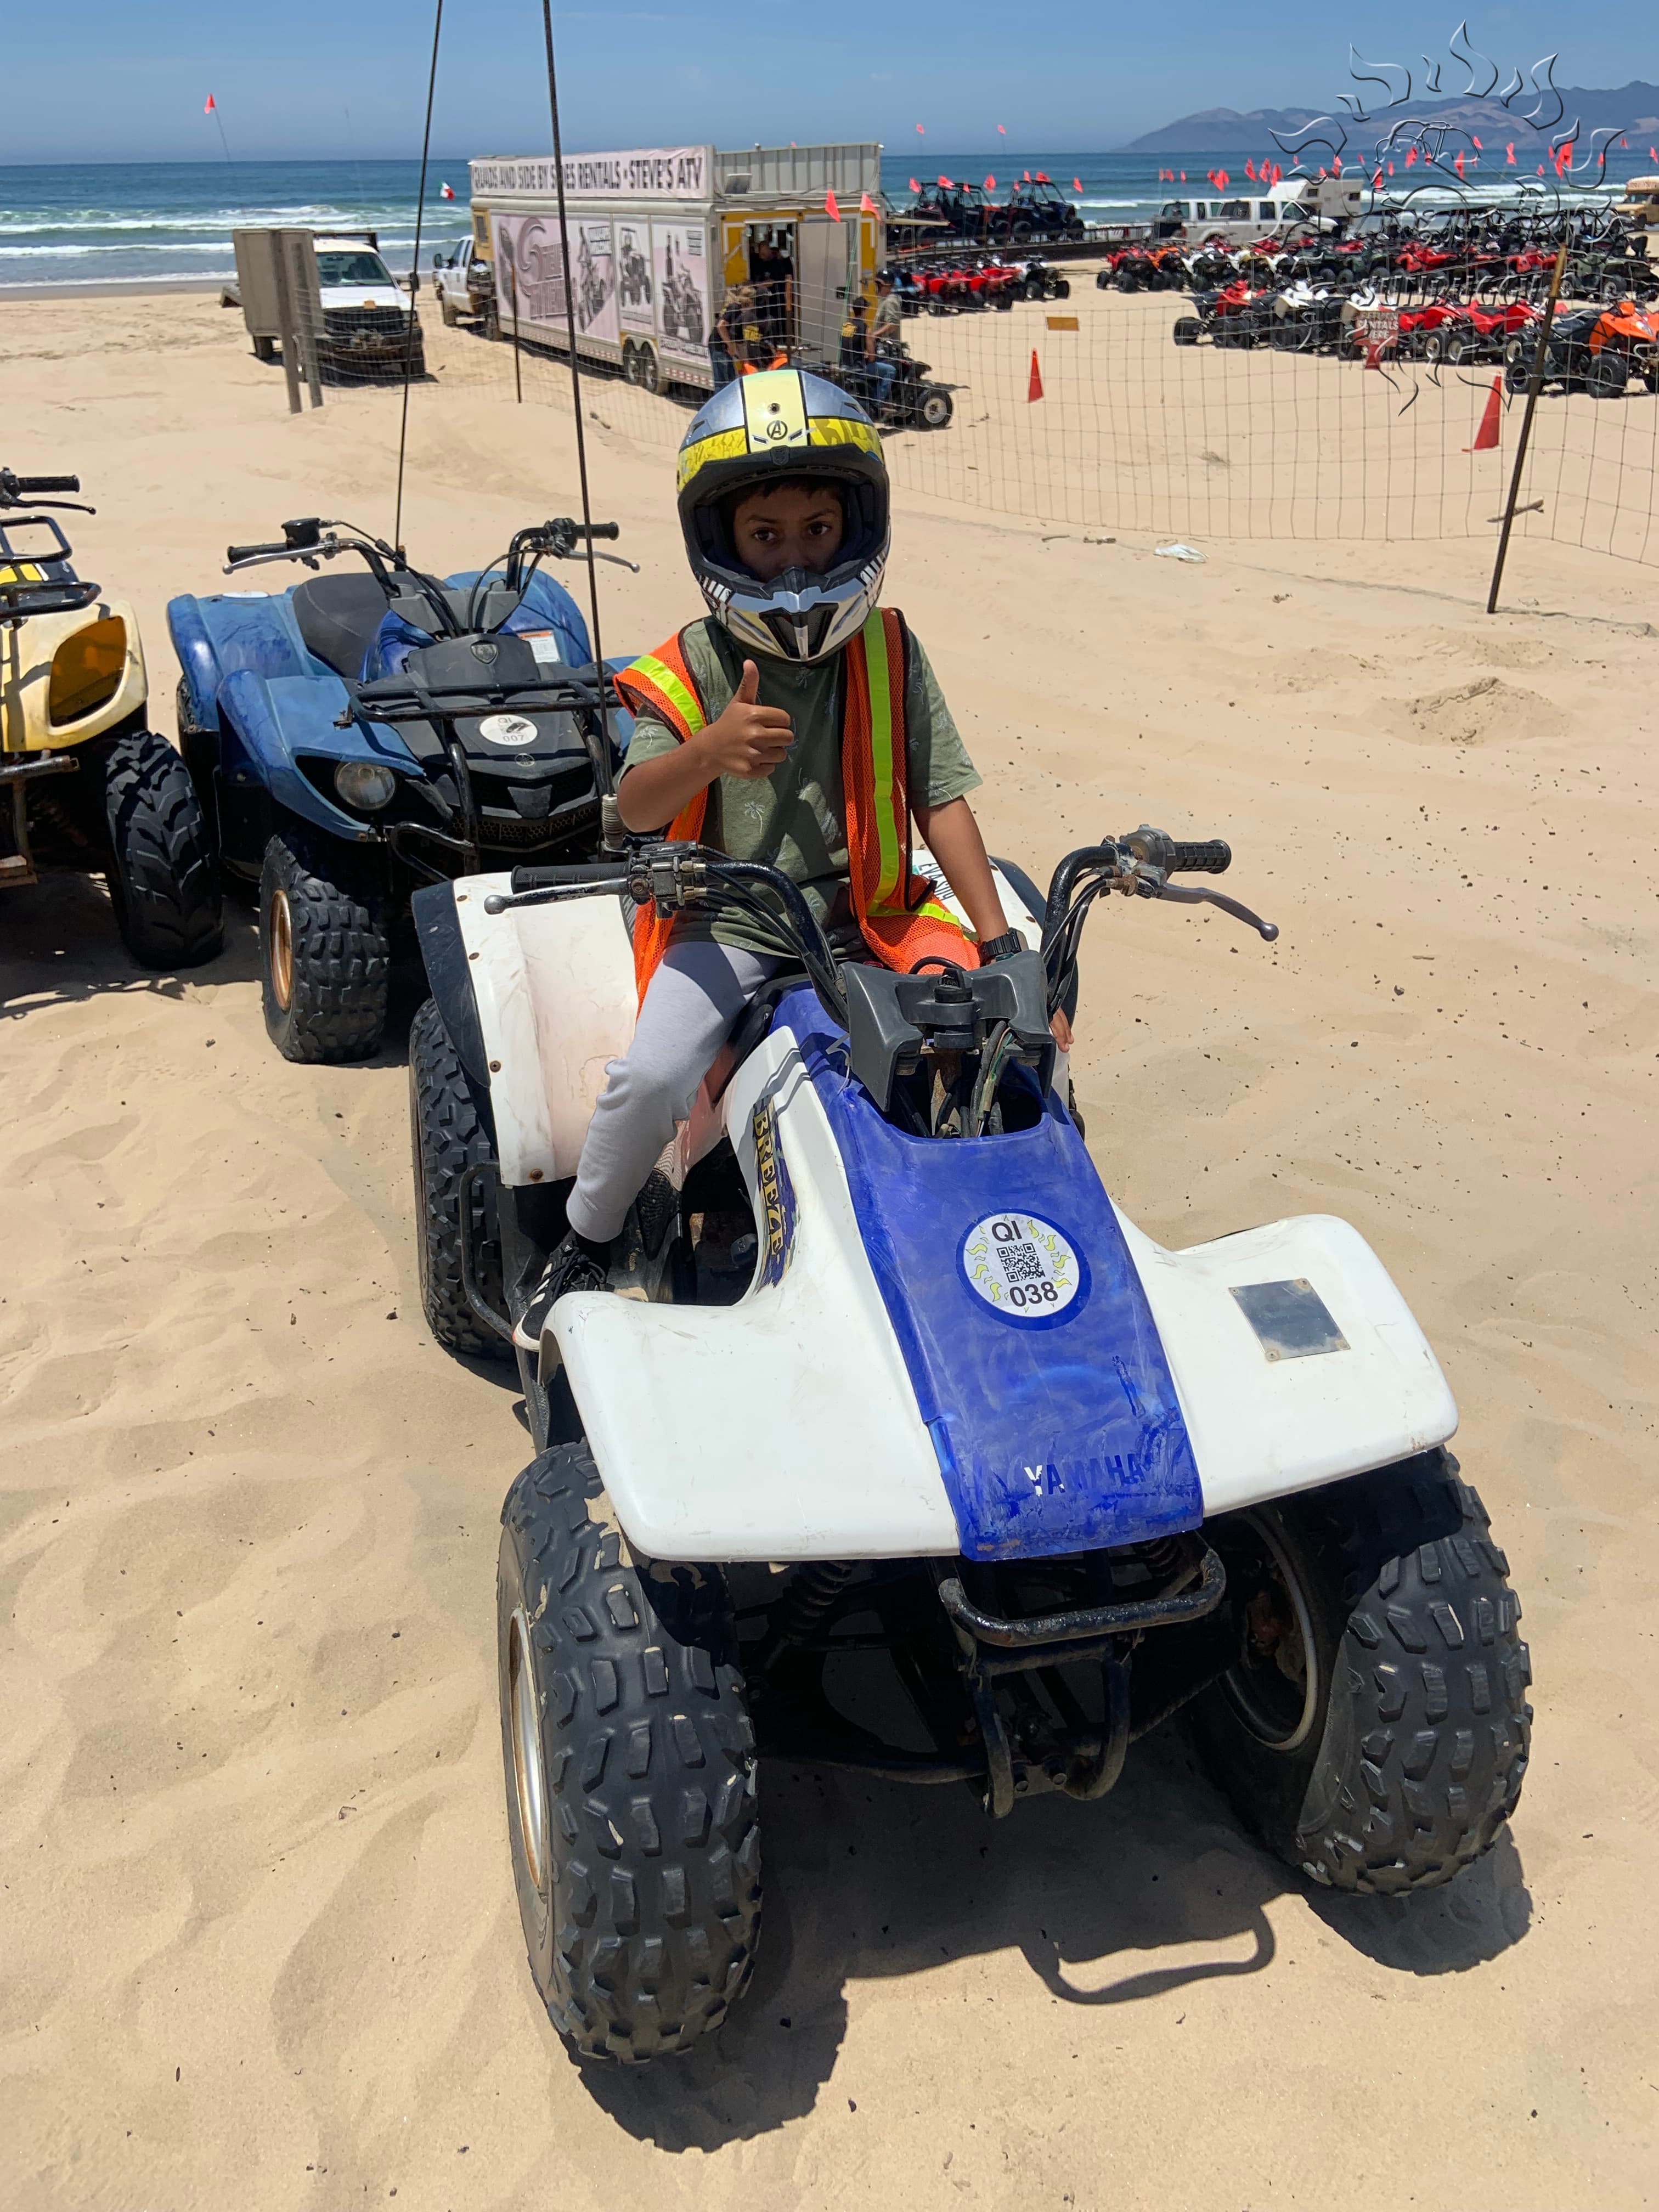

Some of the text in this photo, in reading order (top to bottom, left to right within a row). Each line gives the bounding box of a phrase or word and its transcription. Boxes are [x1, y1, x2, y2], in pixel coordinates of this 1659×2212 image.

[499, 166, 517, 189] AND
[517, 166, 536, 190] SIDE
[537, 165, 549, 189] BY
[578, 161, 621, 189] RENTALS
[629, 159, 673, 189] STEVE'S
[753, 1109, 784, 1256] BREEZE
[991, 1221, 1022, 1242] QI
[1009, 1282, 1058, 1307] 038
[1024, 1453, 1147, 1497] YAMAHA
